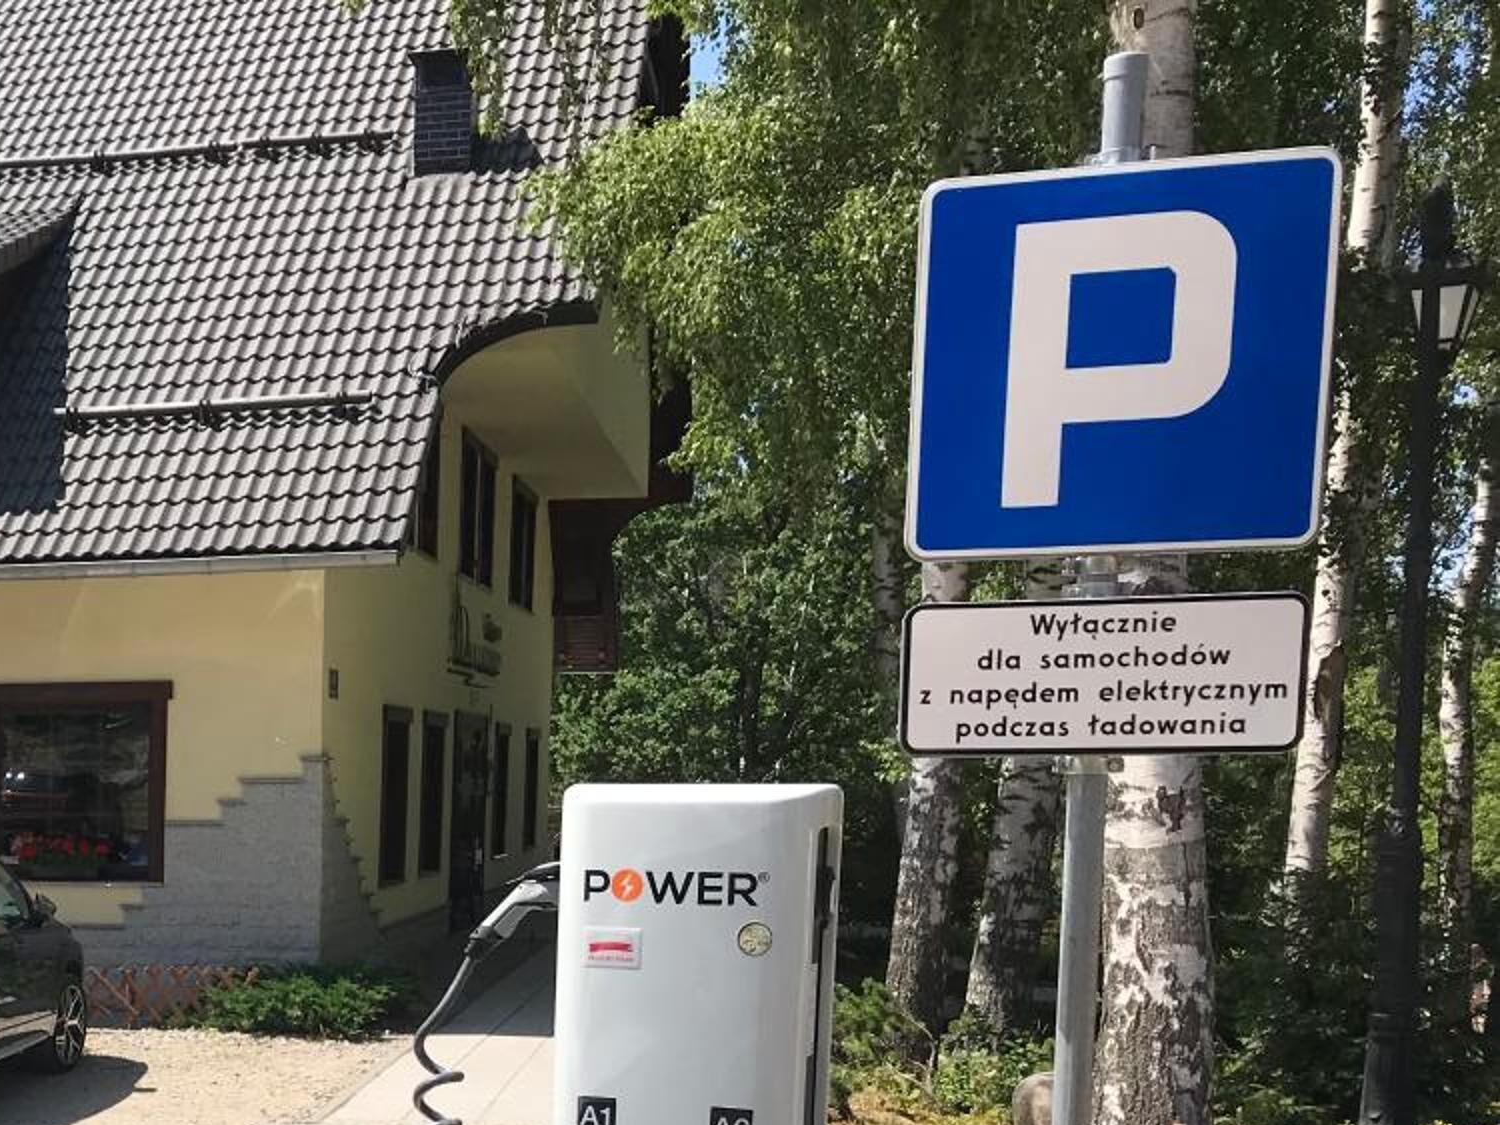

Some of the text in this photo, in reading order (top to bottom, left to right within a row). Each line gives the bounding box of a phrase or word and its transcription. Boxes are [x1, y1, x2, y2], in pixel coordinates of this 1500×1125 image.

[1000, 209, 1238, 508] P
[1030, 611, 1178, 640] Wyłącznie
[977, 643, 1231, 671] dla samochodów
[919, 679, 1289, 710] z napędem elektrycznym
[955, 712, 1247, 743] podczas ładowania
